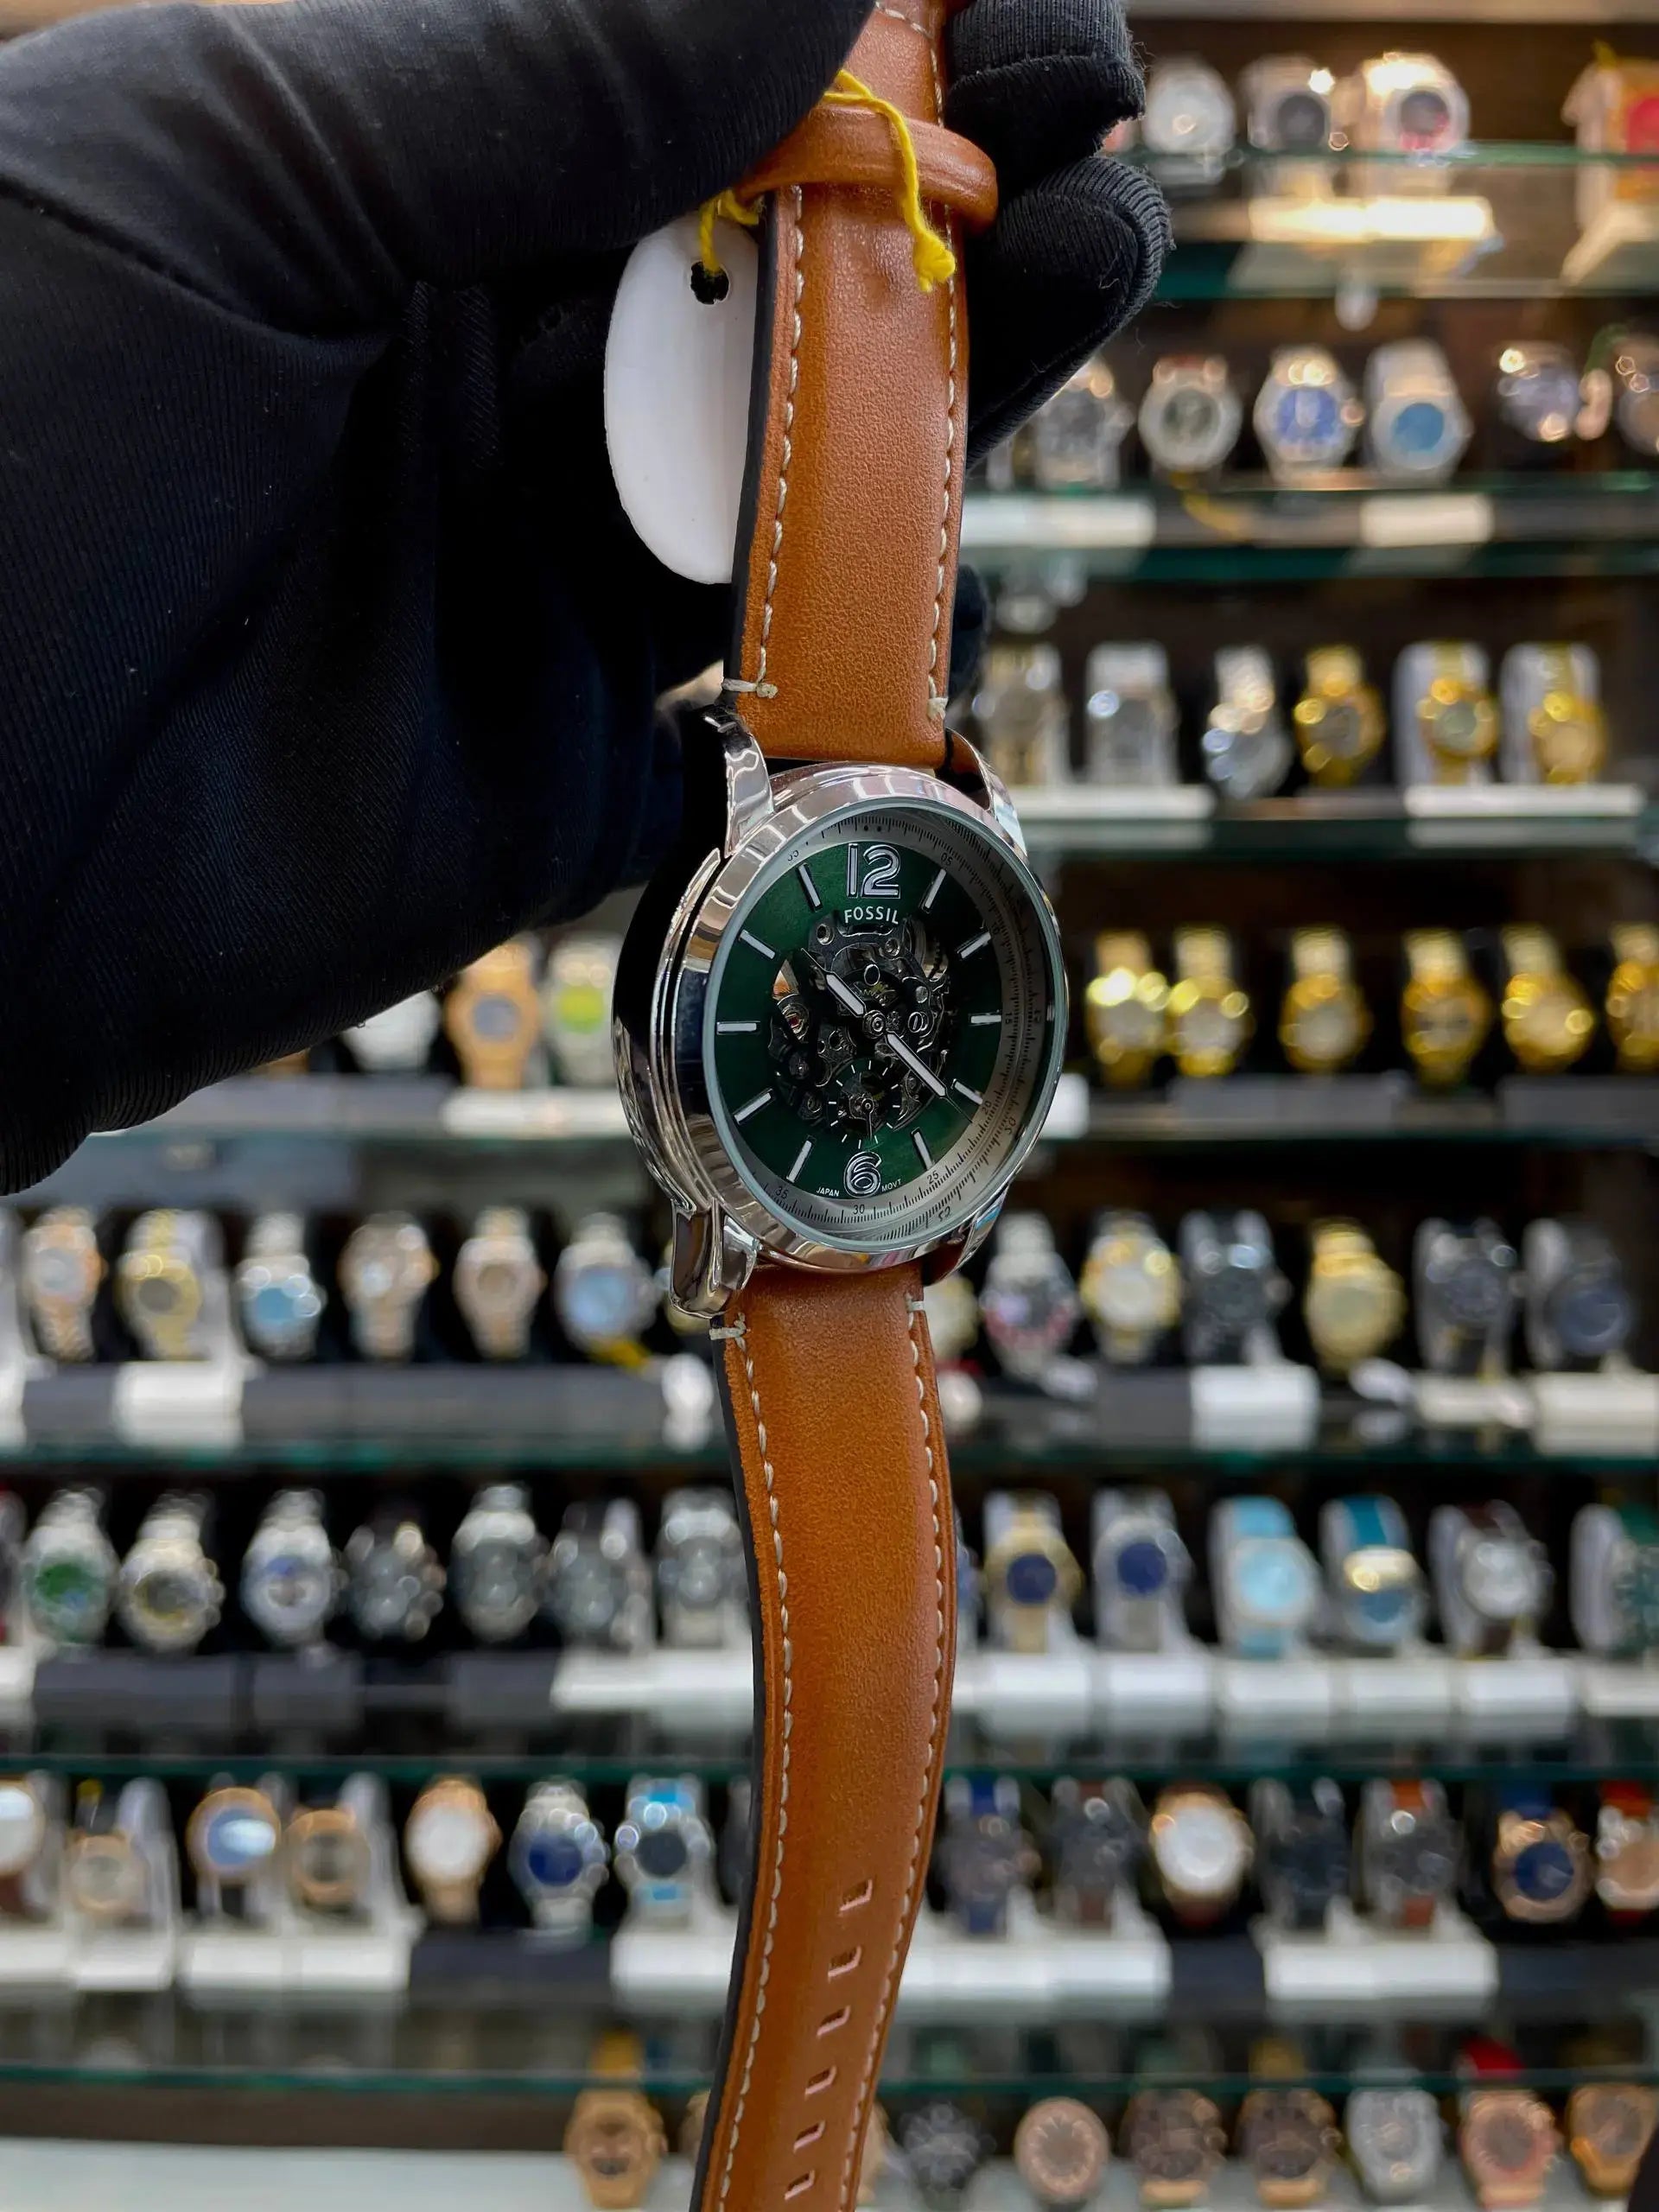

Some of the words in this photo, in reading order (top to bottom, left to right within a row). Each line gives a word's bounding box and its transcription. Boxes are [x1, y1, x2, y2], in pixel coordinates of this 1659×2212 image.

[847, 843, 900, 899] 12
[844, 906, 899, 925] FOSSIL
[982, 1100, 993, 1116] 20
[843, 1151, 881, 1198] 6
[926, 1170, 939, 1185] 25
[775, 1186, 788, 1199] 35
[816, 1186, 840, 1198] JAPAN
[881, 1179, 902, 1192] MOVT
[853, 1204, 864, 1215] 30
